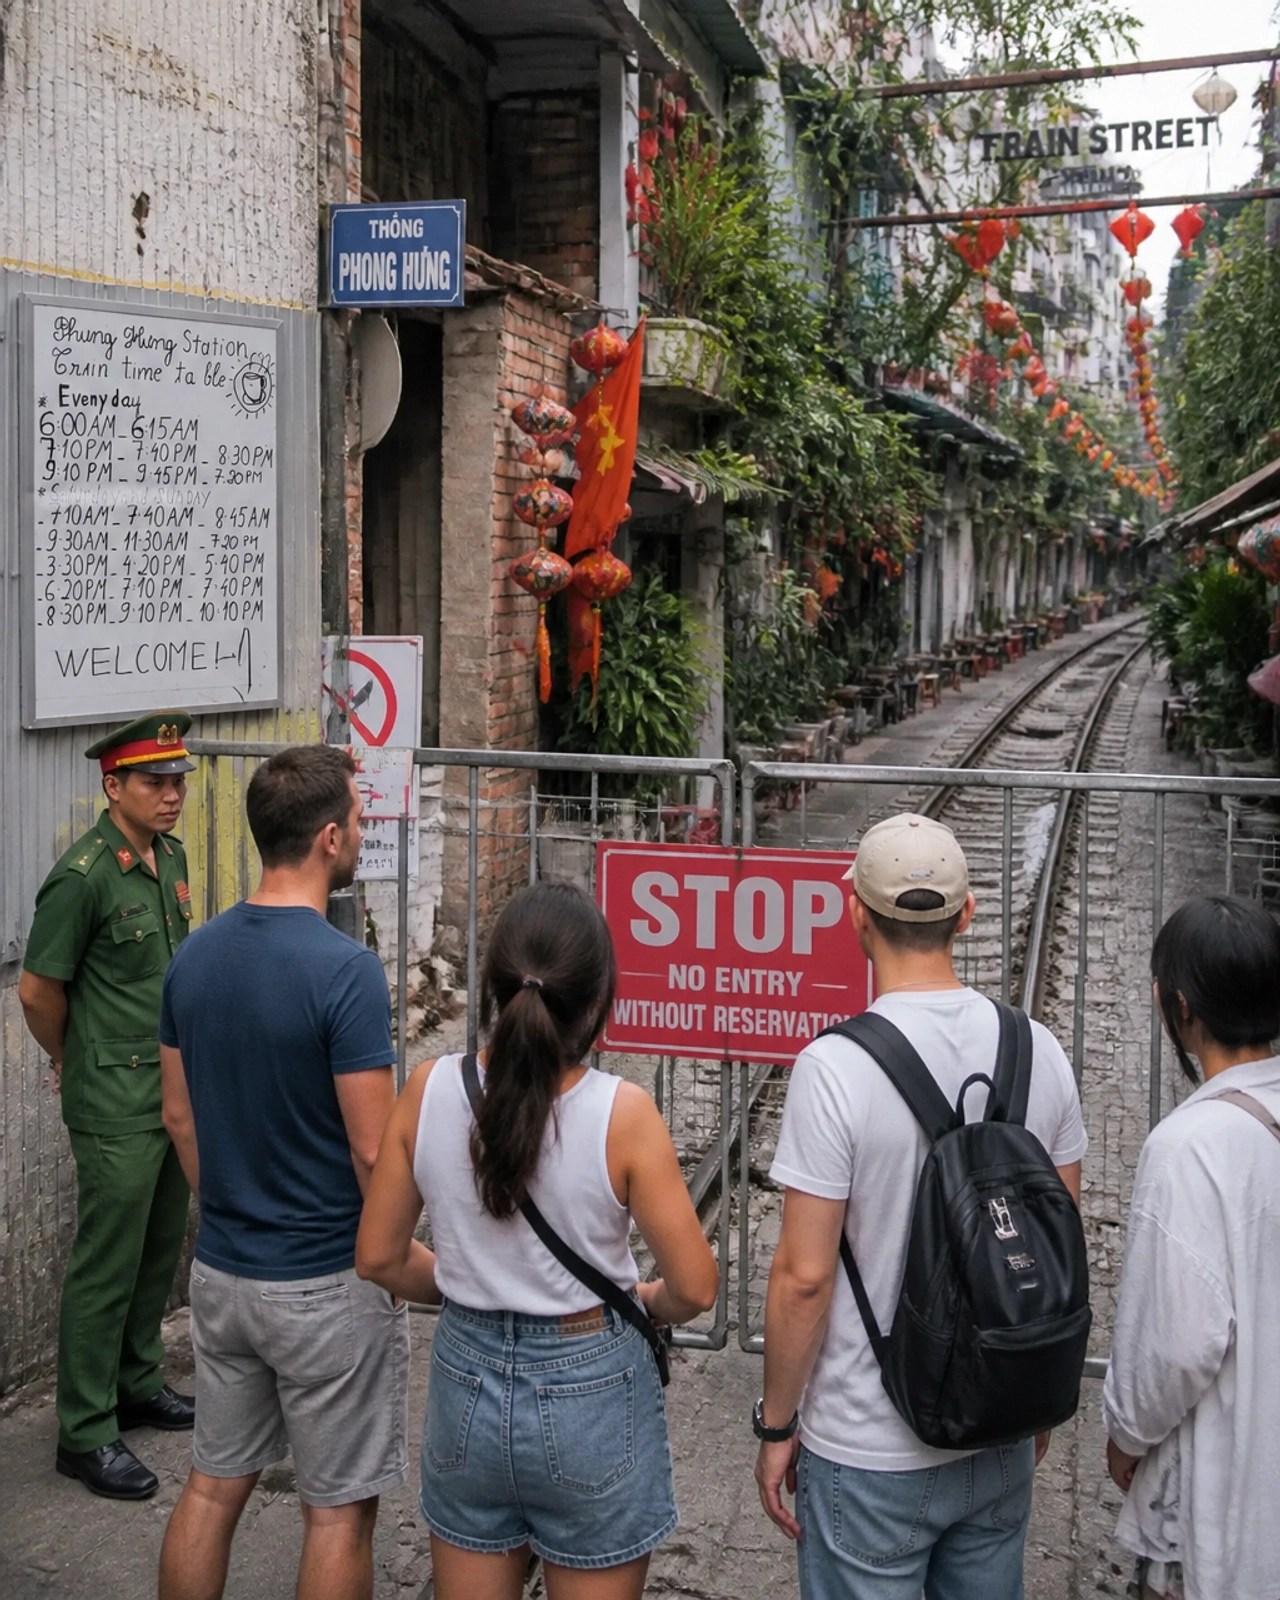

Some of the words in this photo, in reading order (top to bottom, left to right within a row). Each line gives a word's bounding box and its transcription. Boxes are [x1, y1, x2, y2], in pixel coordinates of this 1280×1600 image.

[976, 127, 1079, 162] TRAIN
[1089, 116, 1218, 153] STREET
[339, 251, 397, 291] PHONG
[183, 328, 248, 358] Station
[122, 355, 163, 384] time
[630, 871, 844, 955] STOP
[668, 964, 705, 991] NO
[715, 967, 804, 997] ENTRY
[613, 999, 706, 1031] WITHOUT
[714, 1005, 855, 1039] RESERVATIO
